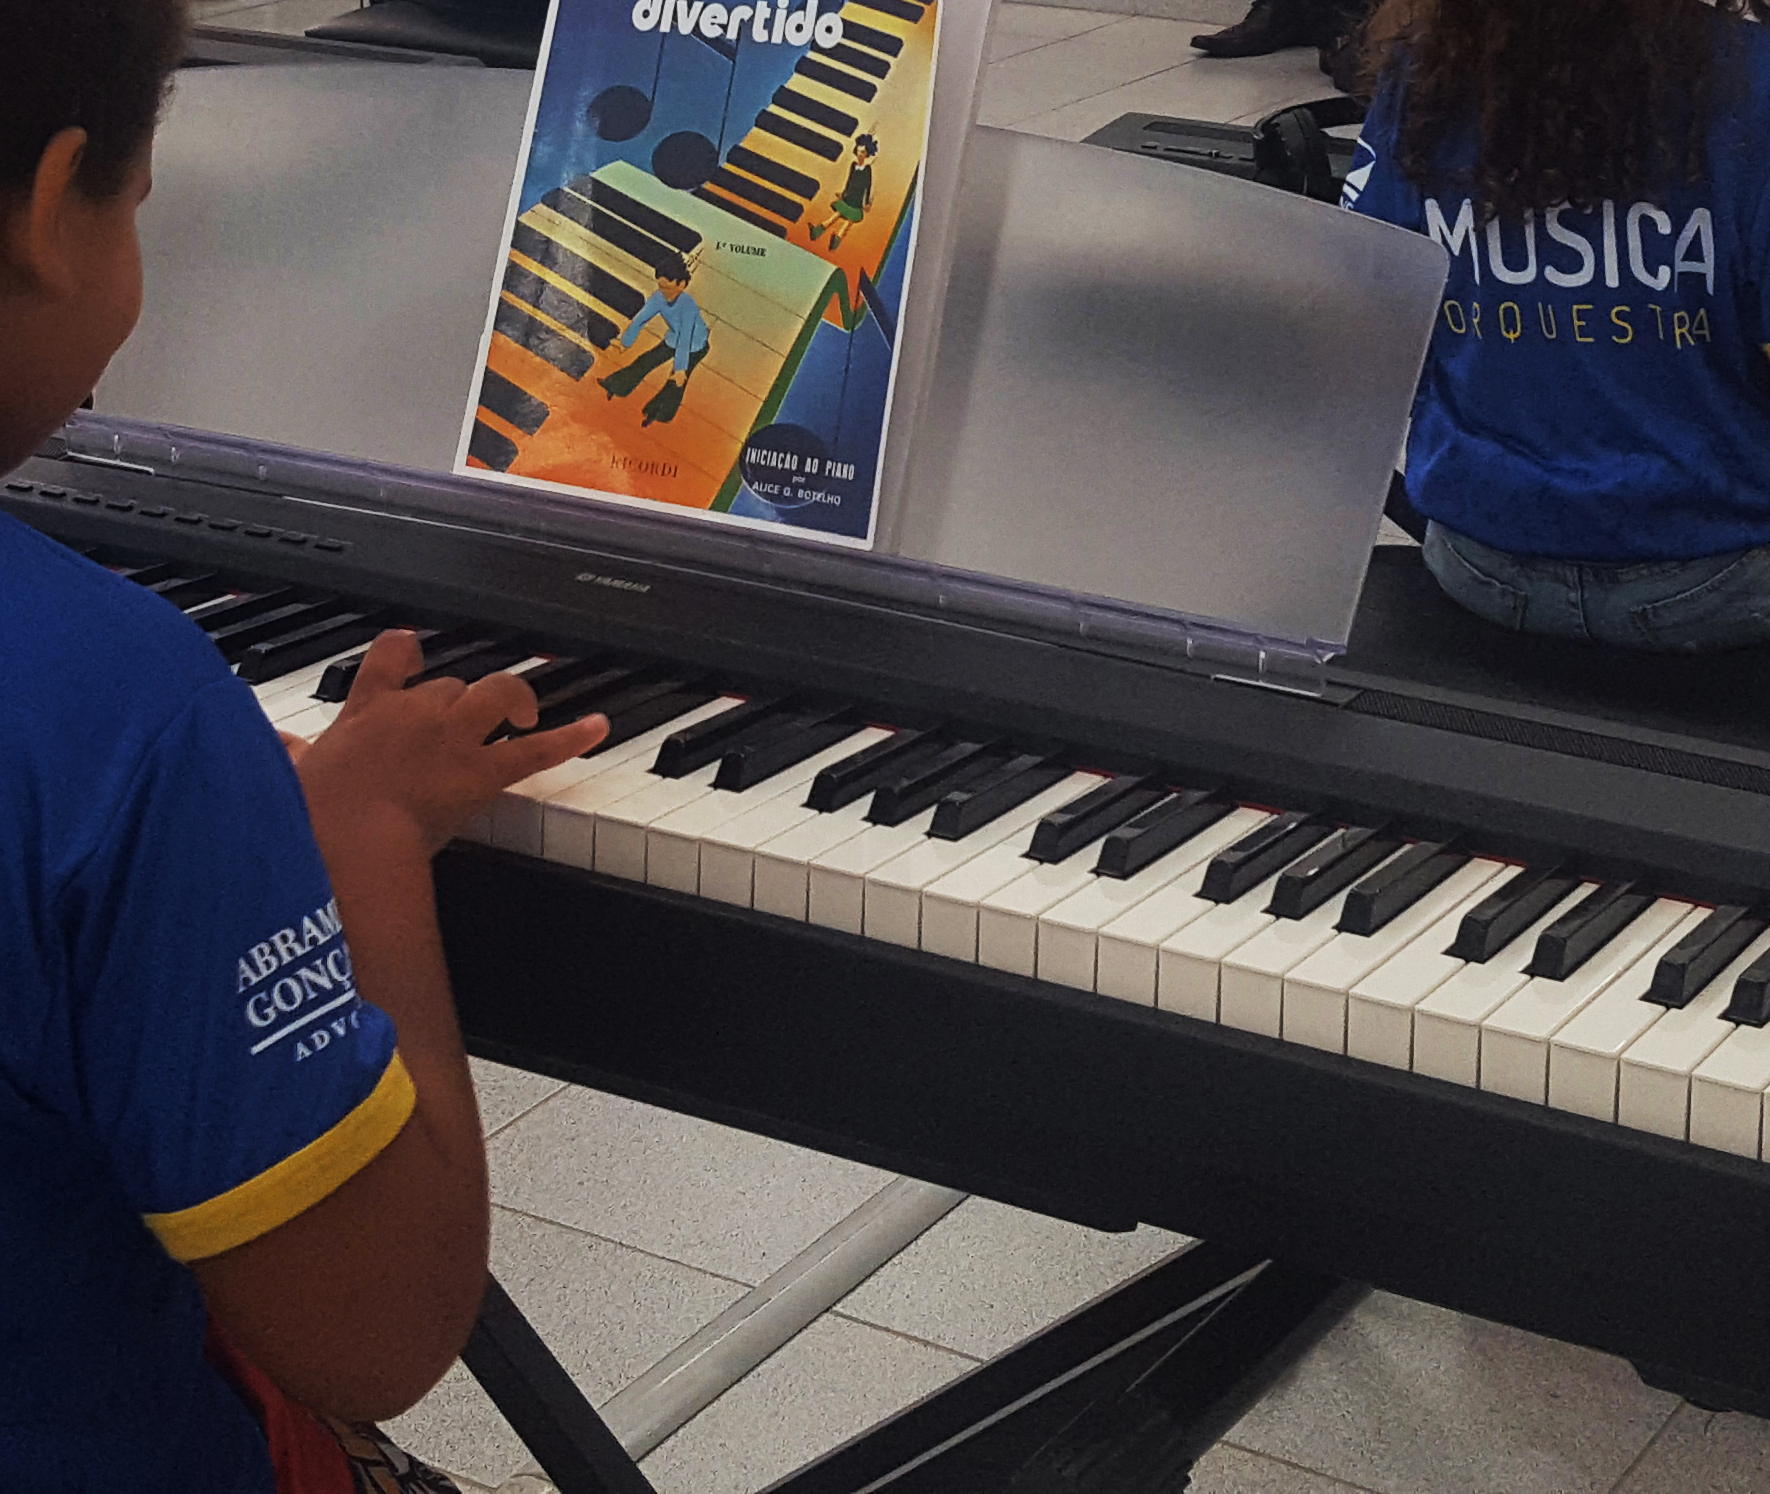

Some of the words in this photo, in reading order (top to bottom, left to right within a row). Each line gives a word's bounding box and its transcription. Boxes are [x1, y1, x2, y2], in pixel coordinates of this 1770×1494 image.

[804, 456, 820, 475] AO
[824, 460, 856, 482] PIANO
[752, 481, 781, 495] ALICE
[237, 897, 343, 994] ABRAM
